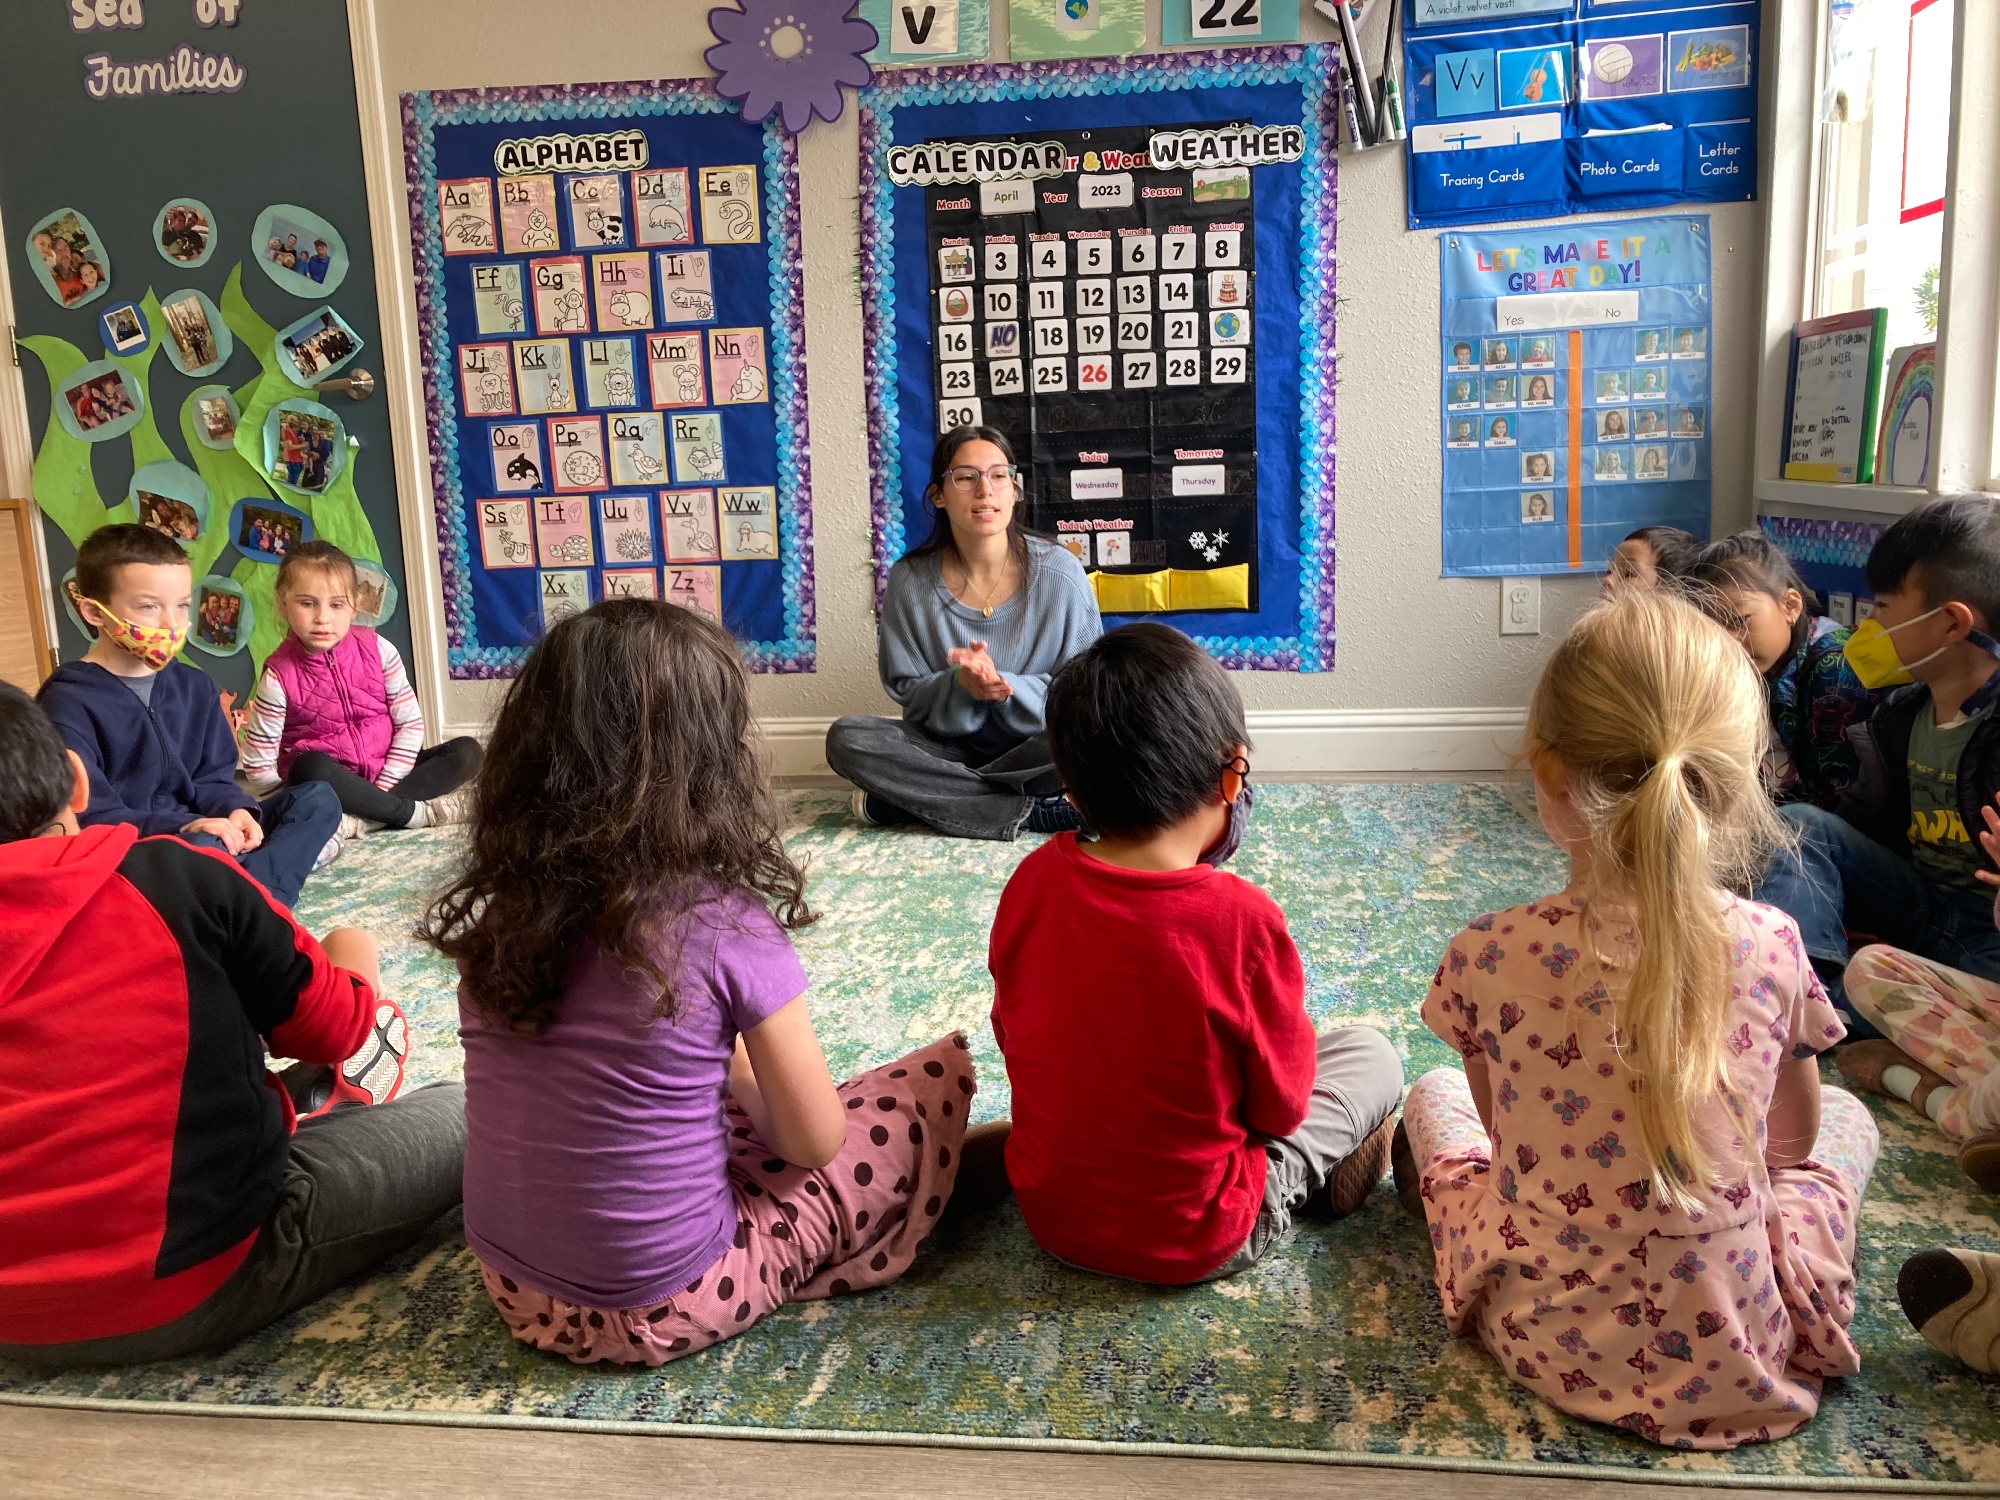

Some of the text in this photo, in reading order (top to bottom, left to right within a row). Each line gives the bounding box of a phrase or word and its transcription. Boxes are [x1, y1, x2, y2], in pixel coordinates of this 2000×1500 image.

[72, 0, 143, 29] Sea
[1199, 0, 1260, 29] 22
[1425, 0, 1515, 16] A violet, velvet vest!
[901, 5, 936, 45] V
[88, 48, 243, 96] Families
[502, 138, 645, 168] ALPHABET
[1152, 131, 1300, 162] WEATHER
[1699, 142, 1740, 157] Letter
[890, 147, 1062, 175] CALENDAR
[1083, 151, 1101, 171] &
[1580, 158, 1660, 176] Photo Cards
[1701, 161, 1739, 176] Cards
[638, 174, 664, 195] Dd
[706, 172, 731, 193] Ee
[1440, 168, 1524, 189] Tracing Cards
[444, 186, 470, 206] Aa
[504, 182, 530, 203] Bb
[573, 180, 599, 200] Cc
[994, 191, 1018, 202] April
[1043, 192, 1068, 203] Year
[1091, 185, 1121, 196] 2023
[1142, 187, 1182, 198] Season
[936, 199, 971, 210] Month
[942, 222, 1245, 246] Sunday Monday Tuesday Wednesday Thursday Friday Saturday
[995, 240, 1228, 271] 3 4 5 6 7 8
[1477, 234, 1671, 271] LET'S MAKE IT A
[476, 268, 500, 288] Ff
[537, 266, 563, 290] Gg
[600, 261, 626, 281] Hh
[1508, 260, 1641, 292] GREAT DAY!
[988, 282, 1188, 312] 10 11 12 13 14
[1504, 307, 1621, 326] Yes No
[944, 332, 967, 352] 16
[990, 323, 1017, 349] NO
[1043, 320, 1193, 346] 18 19 20 21
[651, 338, 687, 358] Mm
[714, 335, 741, 355] Nn
[466, 349, 487, 373] Jj
[520, 346, 546, 366] Kk
[946, 356, 1241, 389] 23 24 25 26 27 28 29
[947, 406, 974, 427] 30
[493, 427, 518, 446] Oo
[555, 424, 578, 447] Pp
[614, 418, 643, 441] Qq
[676, 417, 698, 438] Rr
[1078, 452, 1108, 463] Today
[1174, 449, 1224, 459] Tomorrow
[1075, 481, 1119, 490] Wednesday
[1181, 477, 1216, 487] Thursday
[541, 502, 565, 521] Tt
[603, 499, 627, 518] Uu
[666, 495, 691, 514] Vv
[724, 493, 761, 512] Ww
[485, 505, 507, 523] Ss
[1056, 518, 1134, 532] Today's Weather
[544, 574, 567, 594] Xx
[670, 571, 694, 590] Zz
